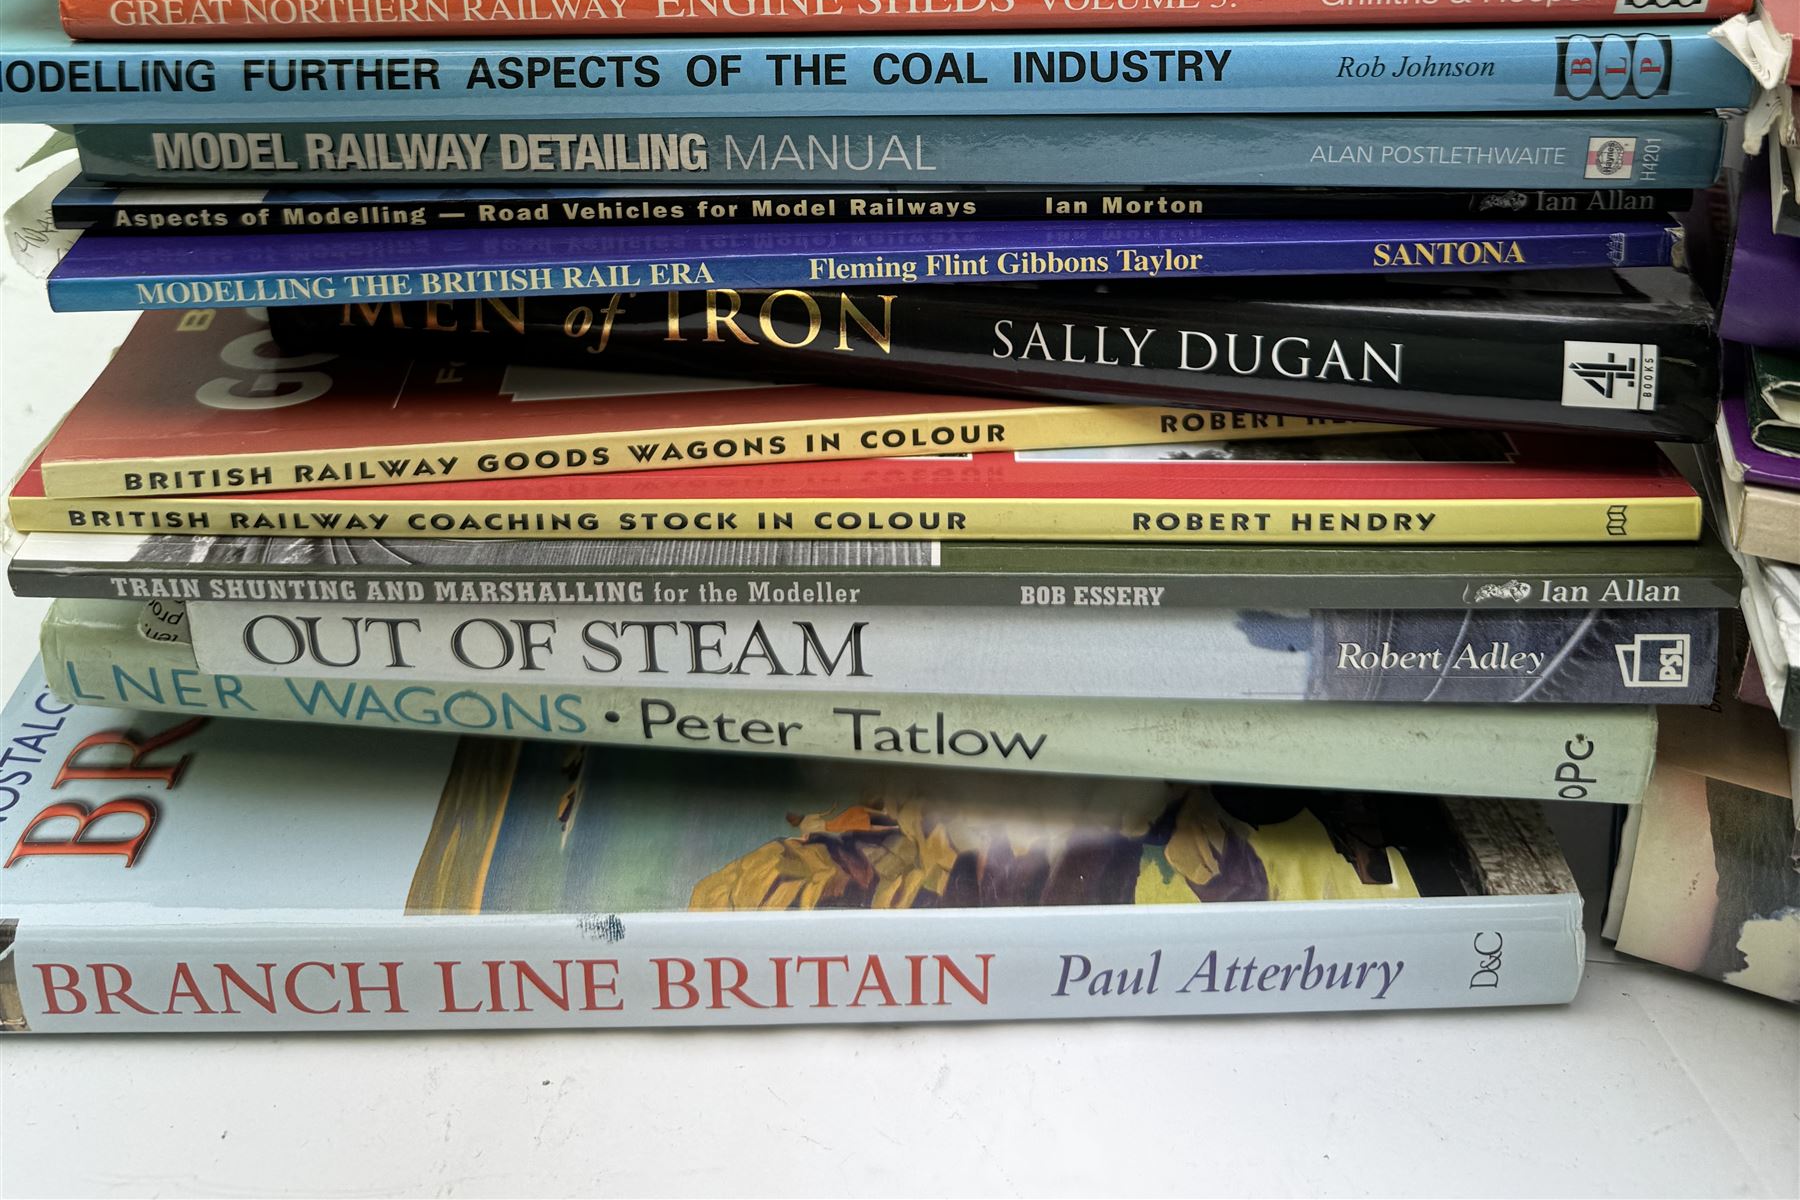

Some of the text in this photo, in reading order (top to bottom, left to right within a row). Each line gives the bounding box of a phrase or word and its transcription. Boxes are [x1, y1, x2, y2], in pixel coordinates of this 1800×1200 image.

[109, 0, 233, 28] GREAT
[0, 49, 1232, 93] ODELLING FURTHER ASPECTS OF THE COAL INDUSTRY
[1336, 54, 1496, 80] Rob Johnson
[151, 132, 938, 172] MODEL RAILWAY DETAILING MANUAL
[1310, 144, 1567, 167] ALAN POSTLETHWAITE
[1601, 141, 1618, 176] Haynes
[1640, 138, 1662, 181] H4201
[115, 197, 978, 228] Aspects of Modelling Road Vehicles for Model Railways
[1045, 195, 1205, 215] Ian Morton
[1536, 189, 1656, 212] Ian Allan
[808, 248, 1203, 284] Fleming Flint Gibbons Taylor
[1372, 241, 1527, 267] SANTONA
[137, 262, 715, 305] MODELLING THE BRITISH RAIL ERA
[664, 288, 898, 354] IRON
[993, 319, 1404, 384] SALLY DUGAN
[1643, 357, 1655, 398] BOOKS
[1160, 411, 1285, 433] ROBERT
[124, 422, 1006, 491] BRITISH RAILWAY GOODS WAGONS IN COLOUR
[68, 508, 967, 532] BRITISH RAILWAY COACHING STOCK IN COLOUR
[1133, 511, 1436, 533] ROBERT HENDRY
[110, 576, 861, 603] TRAIN SHUNTING AND MARSHALLING for the Modeller
[1020, 585, 1166, 607] BOB ESSERY
[1541, 579, 1681, 602] Ian Allan
[242, 614, 421, 668] OUT
[451, 618, 558, 671] OF
[581, 620, 873, 677] STEAM
[1335, 642, 1545, 676] Robert Adley
[1658, 639, 1684, 682] PSL
[67, 660, 1048, 761] LNER WAGONS Peter Tatlow
[1470, 931, 1504, 990] D&C
[33, 944, 1405, 1016] BRANCH LINE BRITAIN Paul Atterbury
